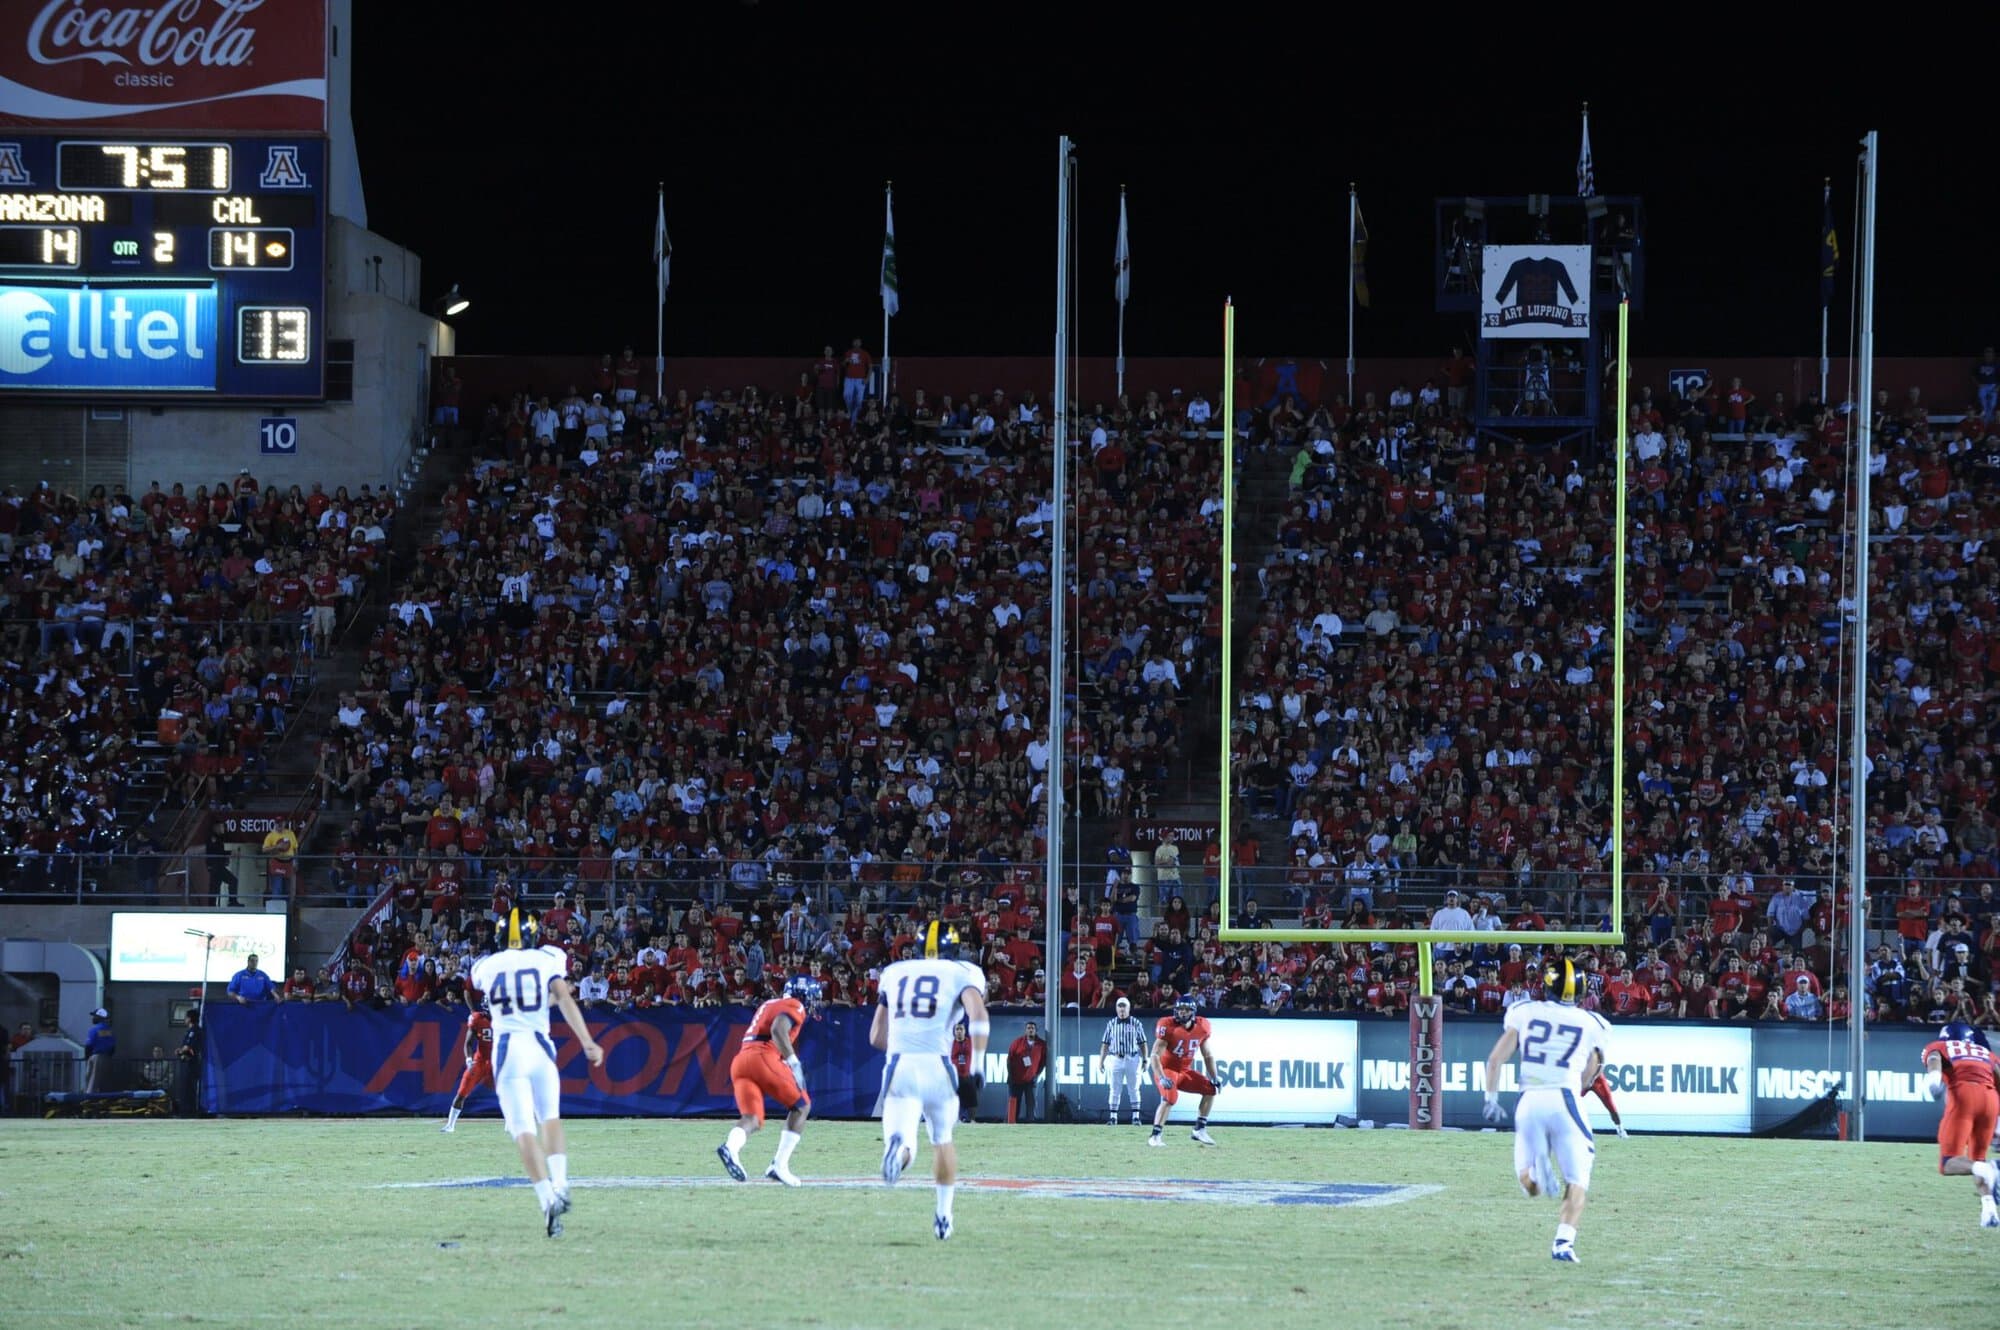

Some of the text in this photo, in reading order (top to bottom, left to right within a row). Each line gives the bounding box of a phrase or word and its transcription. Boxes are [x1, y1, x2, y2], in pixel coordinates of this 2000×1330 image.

[27, 0, 255, 66] Coca-Cola
[114, 72, 175, 87] classic
[102, 146, 227, 188] 7:51
[0, 194, 105, 222] ARIZONA
[212, 197, 262, 224] CAL
[42, 229, 77, 264] 14
[153, 232, 174, 262] 2
[223, 231, 257, 266] 14
[18, 290, 203, 360] alltel
[1504, 305, 1524, 321] ART
[1527, 304, 1570, 321] LUPPINO
[262, 310, 306, 359] 13
[261, 423, 296, 449] 10
[225, 819, 237, 833] 10
[240, 819, 276, 833] SECTIO
[489, 967, 542, 1016] 40
[894, 975, 940, 1019] 18
[1522, 1018, 1583, 1069] 27
[1279, 1059, 1345, 1089] MILK
[1362, 1058, 1520, 1092] MUSLE MIL
[1413, 1002, 1439, 1123] WILDCATS
[1671, 1063, 1739, 1095] MILK
